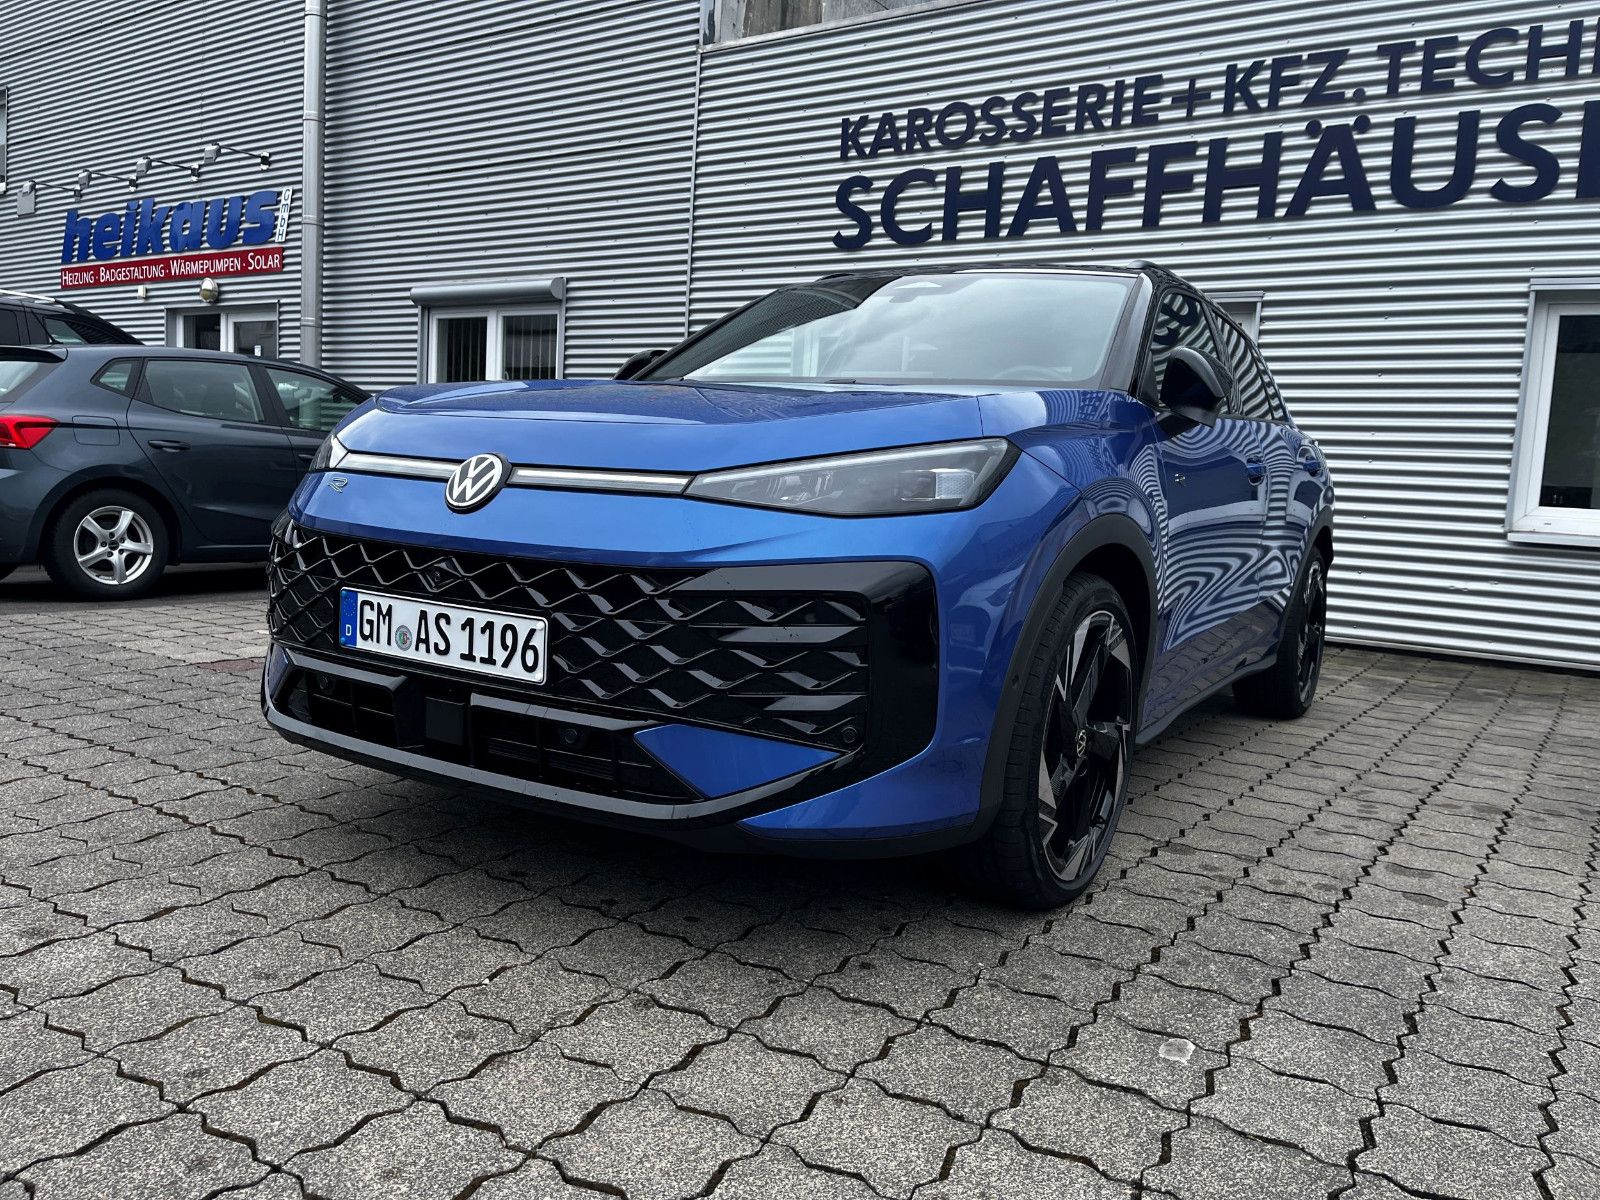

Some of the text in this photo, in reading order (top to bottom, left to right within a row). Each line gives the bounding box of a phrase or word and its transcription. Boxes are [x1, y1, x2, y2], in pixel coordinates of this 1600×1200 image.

[1377, 17, 1600, 97] TECH
[61, 190, 278, 265] heikaus
[277, 188, 291, 241] GmbH
[359, 599, 539, 673] GM AS 1196
